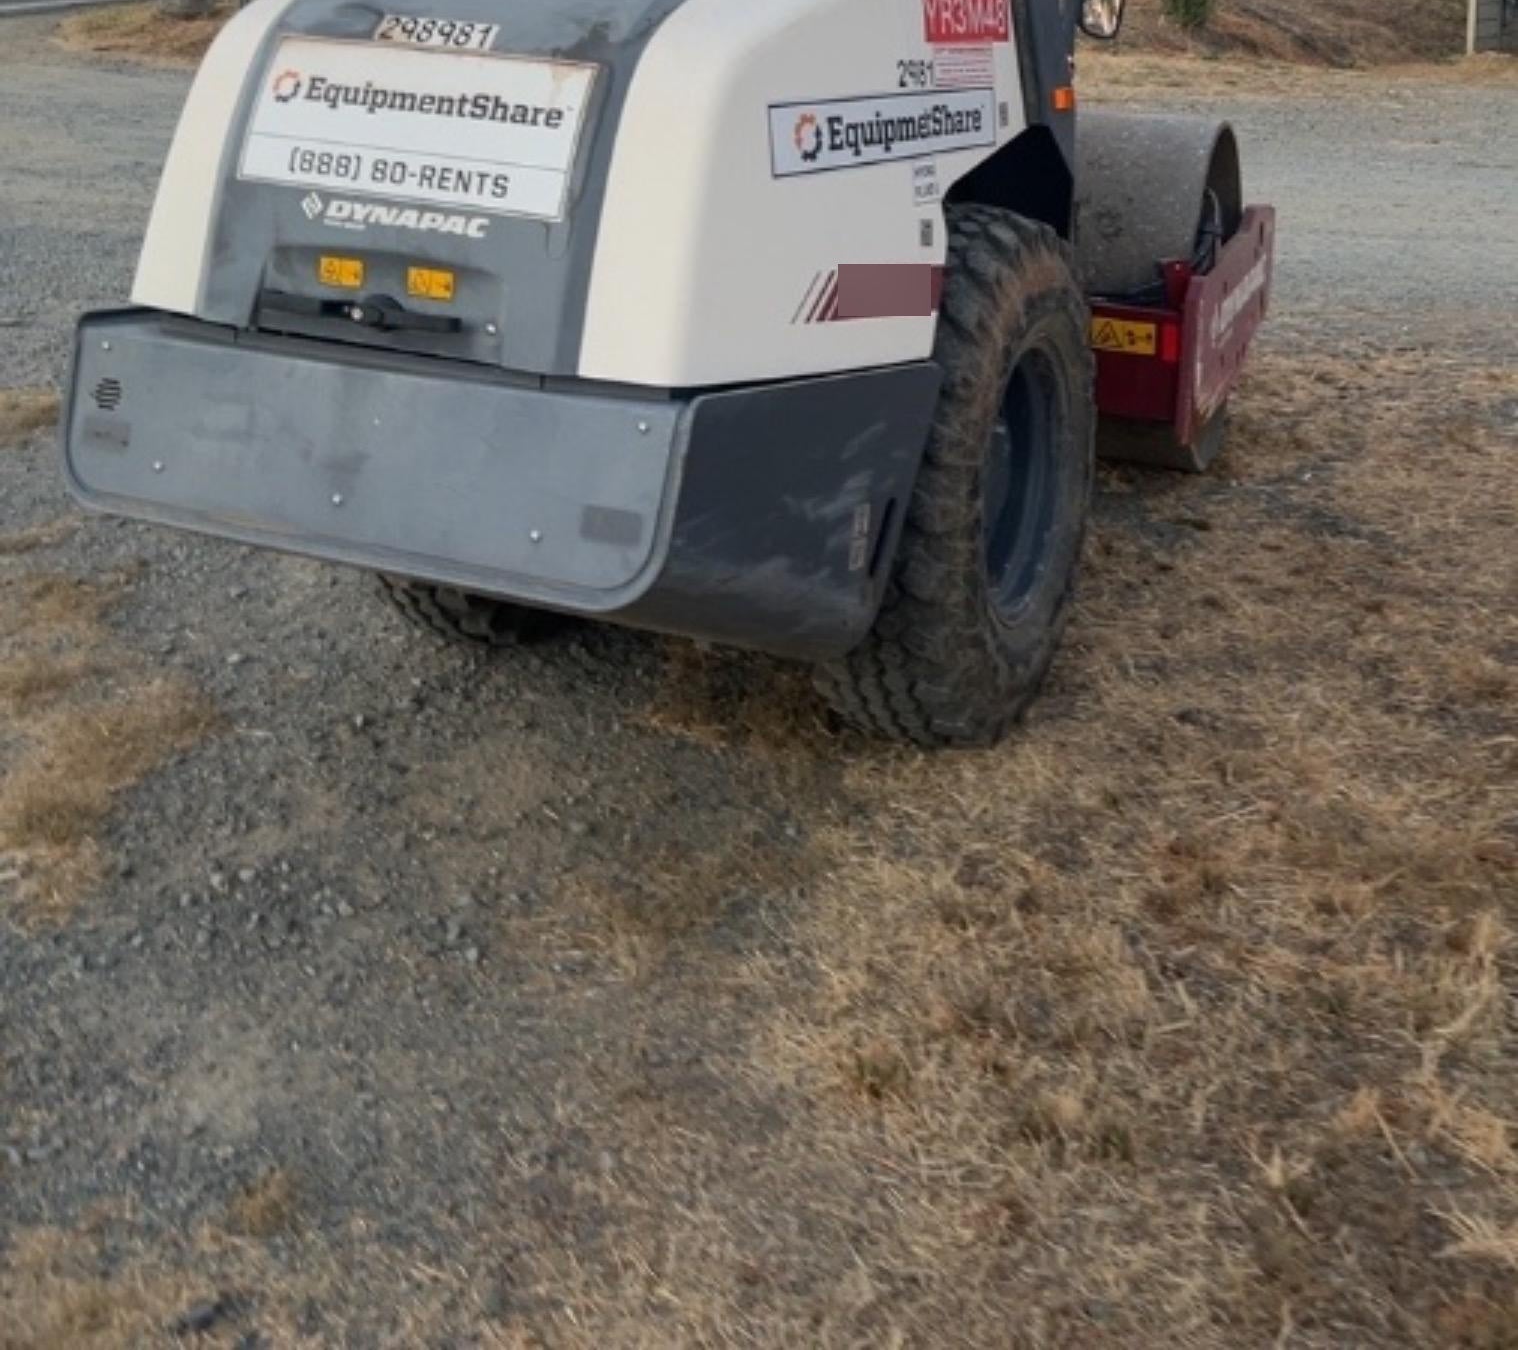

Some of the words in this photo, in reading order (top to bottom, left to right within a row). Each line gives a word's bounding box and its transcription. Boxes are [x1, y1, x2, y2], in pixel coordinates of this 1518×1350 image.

[380, 16, 493, 49] 298981
[304, 76, 564, 129] EquipmentShare
[288, 146, 361, 181] (888)
[370, 158, 509, 198] 80-RENTS
[326, 199, 490, 238] DYNAPAC
